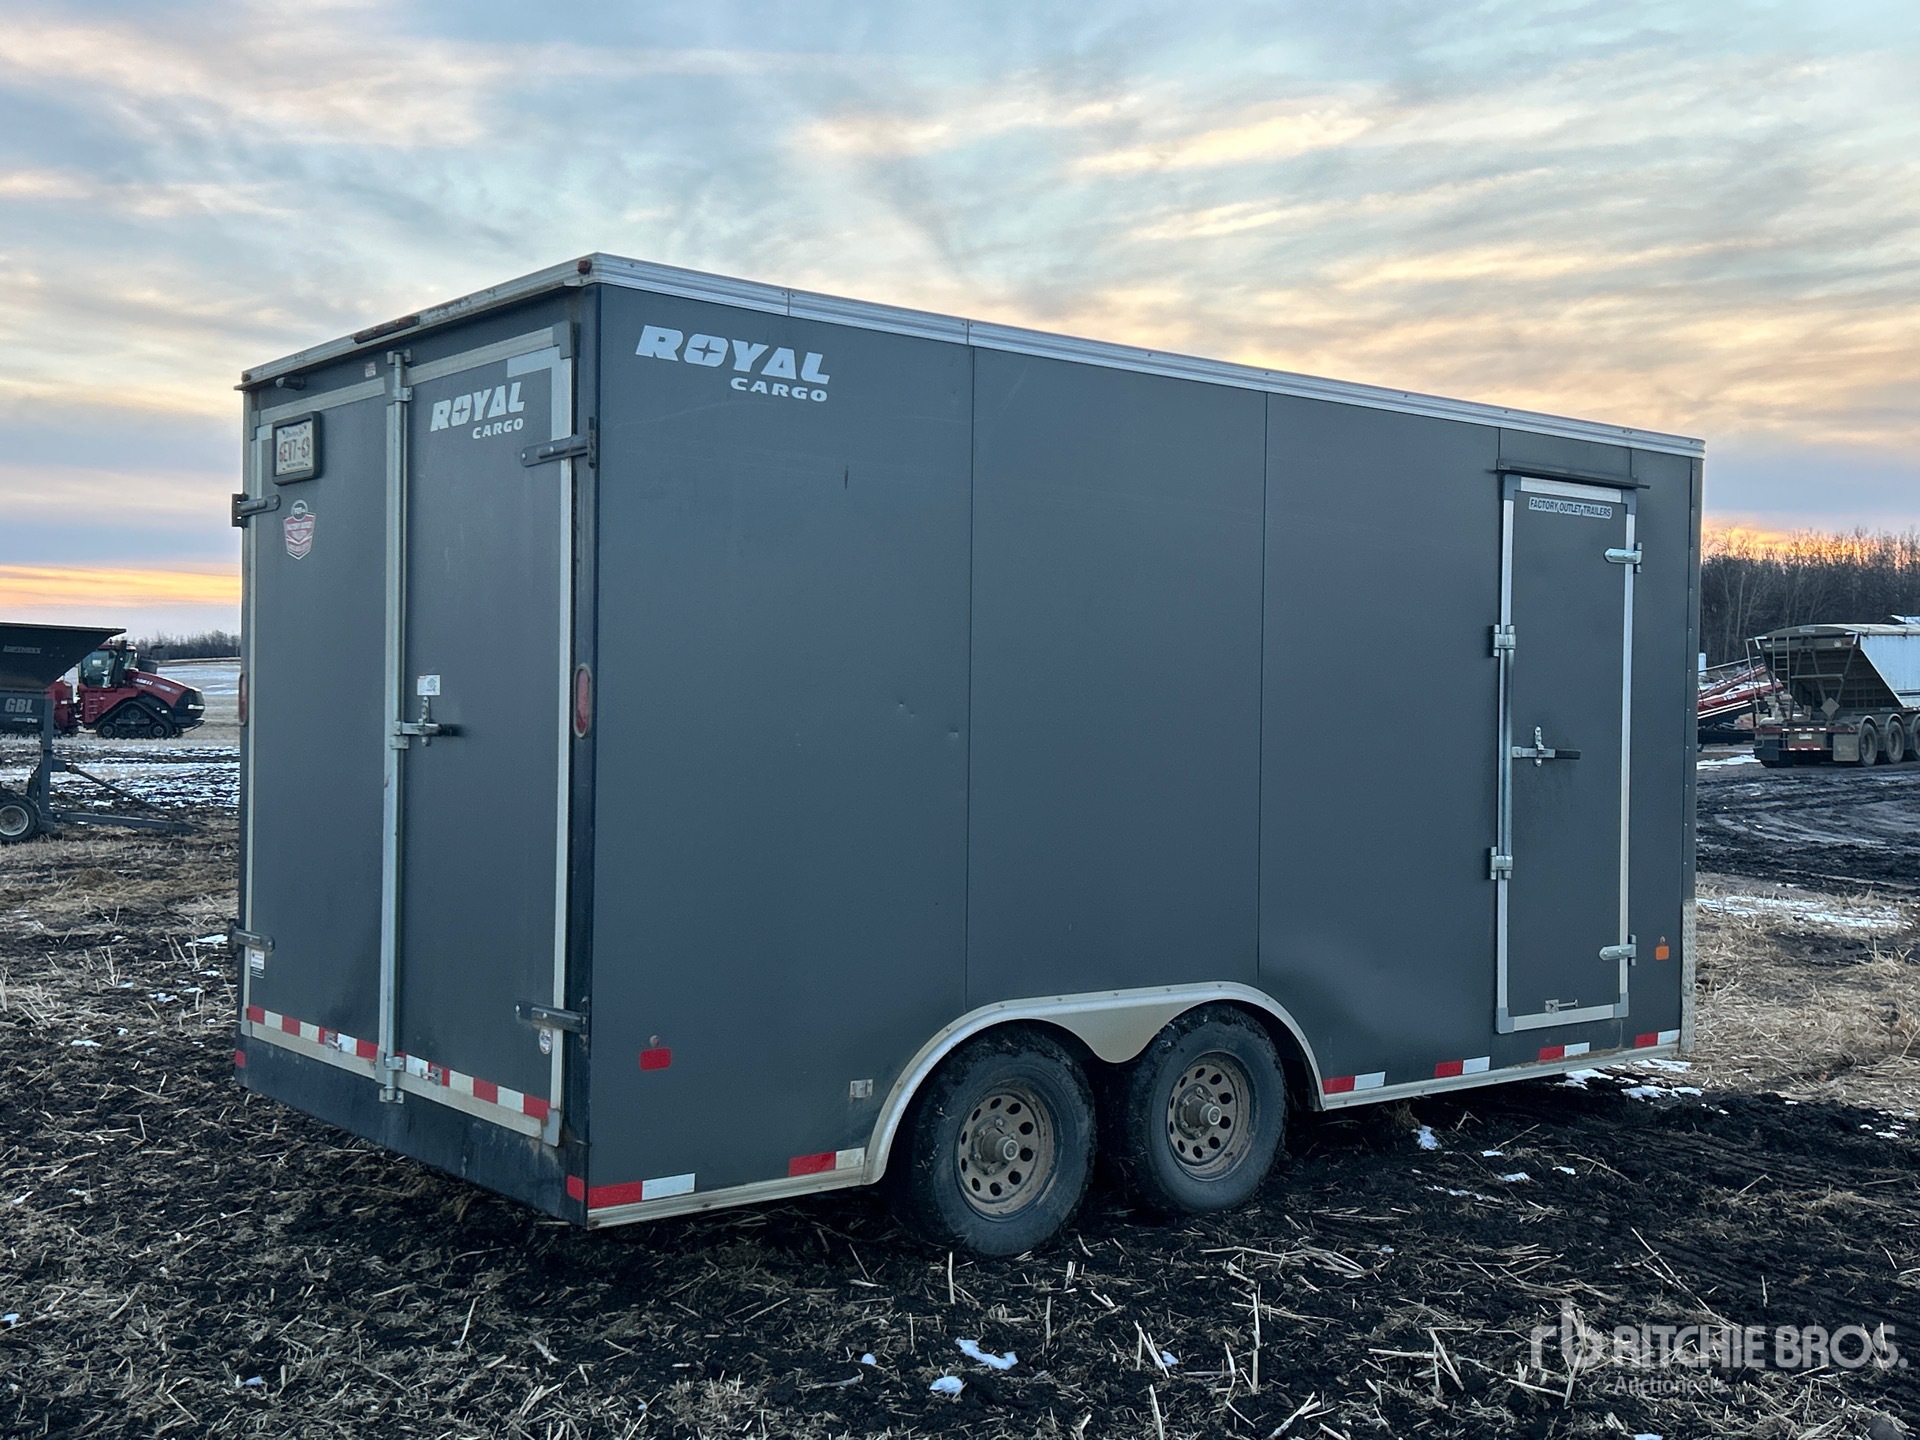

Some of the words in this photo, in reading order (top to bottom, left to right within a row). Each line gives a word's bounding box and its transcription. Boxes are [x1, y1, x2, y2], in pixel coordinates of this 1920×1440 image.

[635, 325, 831, 385] ROYAL
[730, 377, 828, 403] CARGO
[430, 381, 526, 433] ROYAL
[472, 417, 525, 440] CARGO
[1530, 498, 1558, 511] FACTORY
[1559, 502, 1582, 514] OUTLET
[1583, 505, 1612, 517] TRAILERS
[4, 697, 34, 713] GBL
